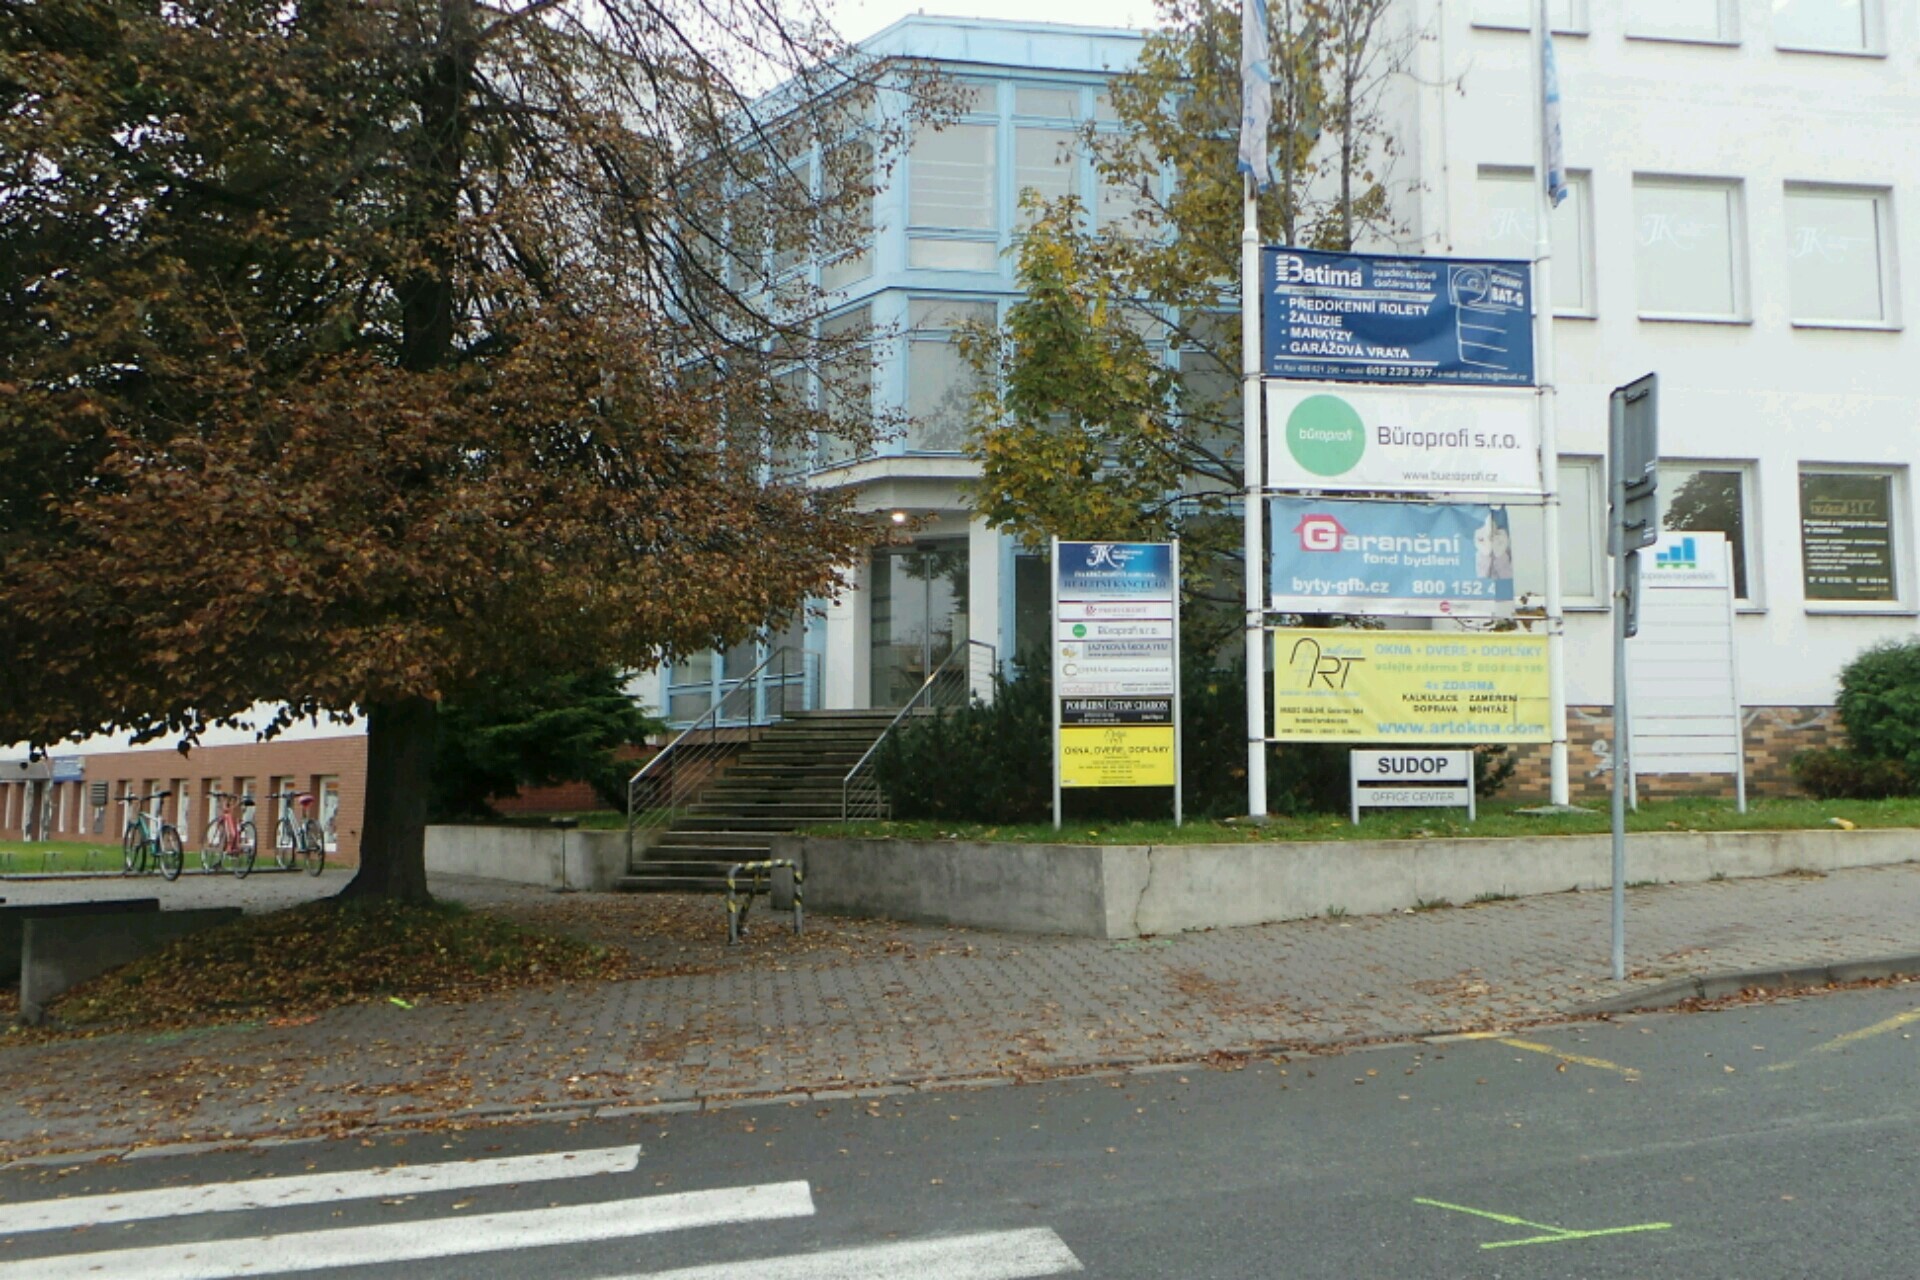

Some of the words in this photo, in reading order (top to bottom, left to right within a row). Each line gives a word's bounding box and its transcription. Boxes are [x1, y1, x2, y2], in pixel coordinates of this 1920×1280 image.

[1275, 253, 1363, 288] Batima
[1289, 297, 1376, 314] PŘEDOKENNÍ
[1379, 302, 1430, 316] ROLETY
[1289, 311, 1343, 327] ŽALUZIE
[1290, 326, 1354, 343] MARKÝZY
[1290, 341, 1364, 358] GARÁŽOVÁ
[1367, 346, 1410, 359] VRATA
[1299, 428, 1354, 443] büroprofi
[1377, 425, 1470, 452] Büroprofi
[1474, 431, 1521, 449] s.r.o.
[1302, 520, 1460, 555] Garanční
[1363, 552, 1398, 566] fond
[1292, 576, 1390, 596] byty-gfb.cz
[1412, 579, 1445, 596] 800
[1451, 580, 1483, 596] 152
[1375, 643, 1413, 656] OKNA
[1425, 642, 1468, 657] DVEŘE
[1481, 643, 1543, 657] DOPLŇKY
[1442, 680, 1496, 691] ZDARMA
[1402, 693, 1459, 703] KALKULACE
[1469, 692, 1518, 703] ZAMĚŘENÍ
[1413, 704, 1458, 713] DOPRAVA
[1469, 703, 1509, 714] MONTÁŽ
[1377, 757, 1449, 774] SUDOP
[1370, 791, 1410, 803] OFFICE
[1411, 791, 1455, 802] CENTER
